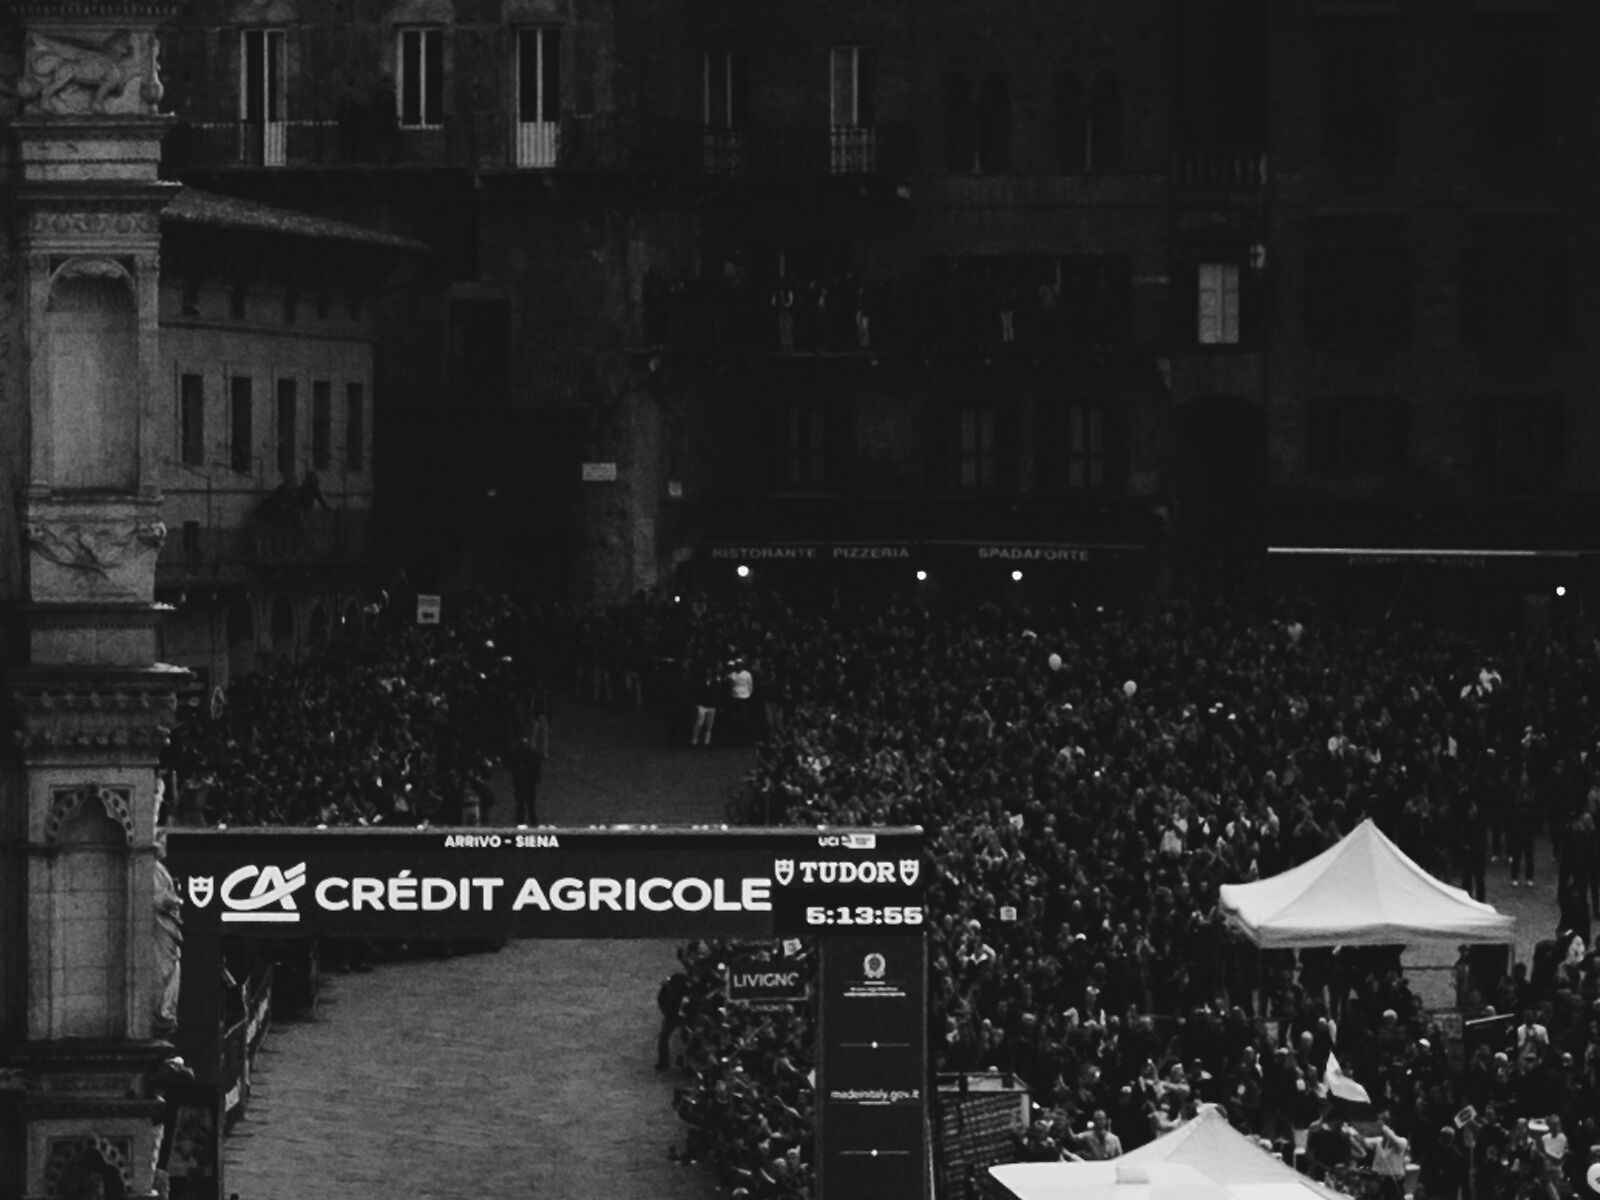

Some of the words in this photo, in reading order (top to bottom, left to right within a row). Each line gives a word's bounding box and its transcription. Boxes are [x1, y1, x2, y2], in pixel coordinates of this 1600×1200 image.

[712, 548, 817, 559] RISTORANTE
[832, 548, 909, 559] PIZZERIA
[978, 548, 1089, 561] SPADAFORTE
[444, 835, 501, 848] ARRIVO
[515, 835, 559, 848] SIENA
[799, 861, 897, 883] TUDOR
[314, 869, 505, 911] CRÉDIT
[512, 877, 773, 911] AGRICOLE
[806, 906, 923, 925] 5:13:55
